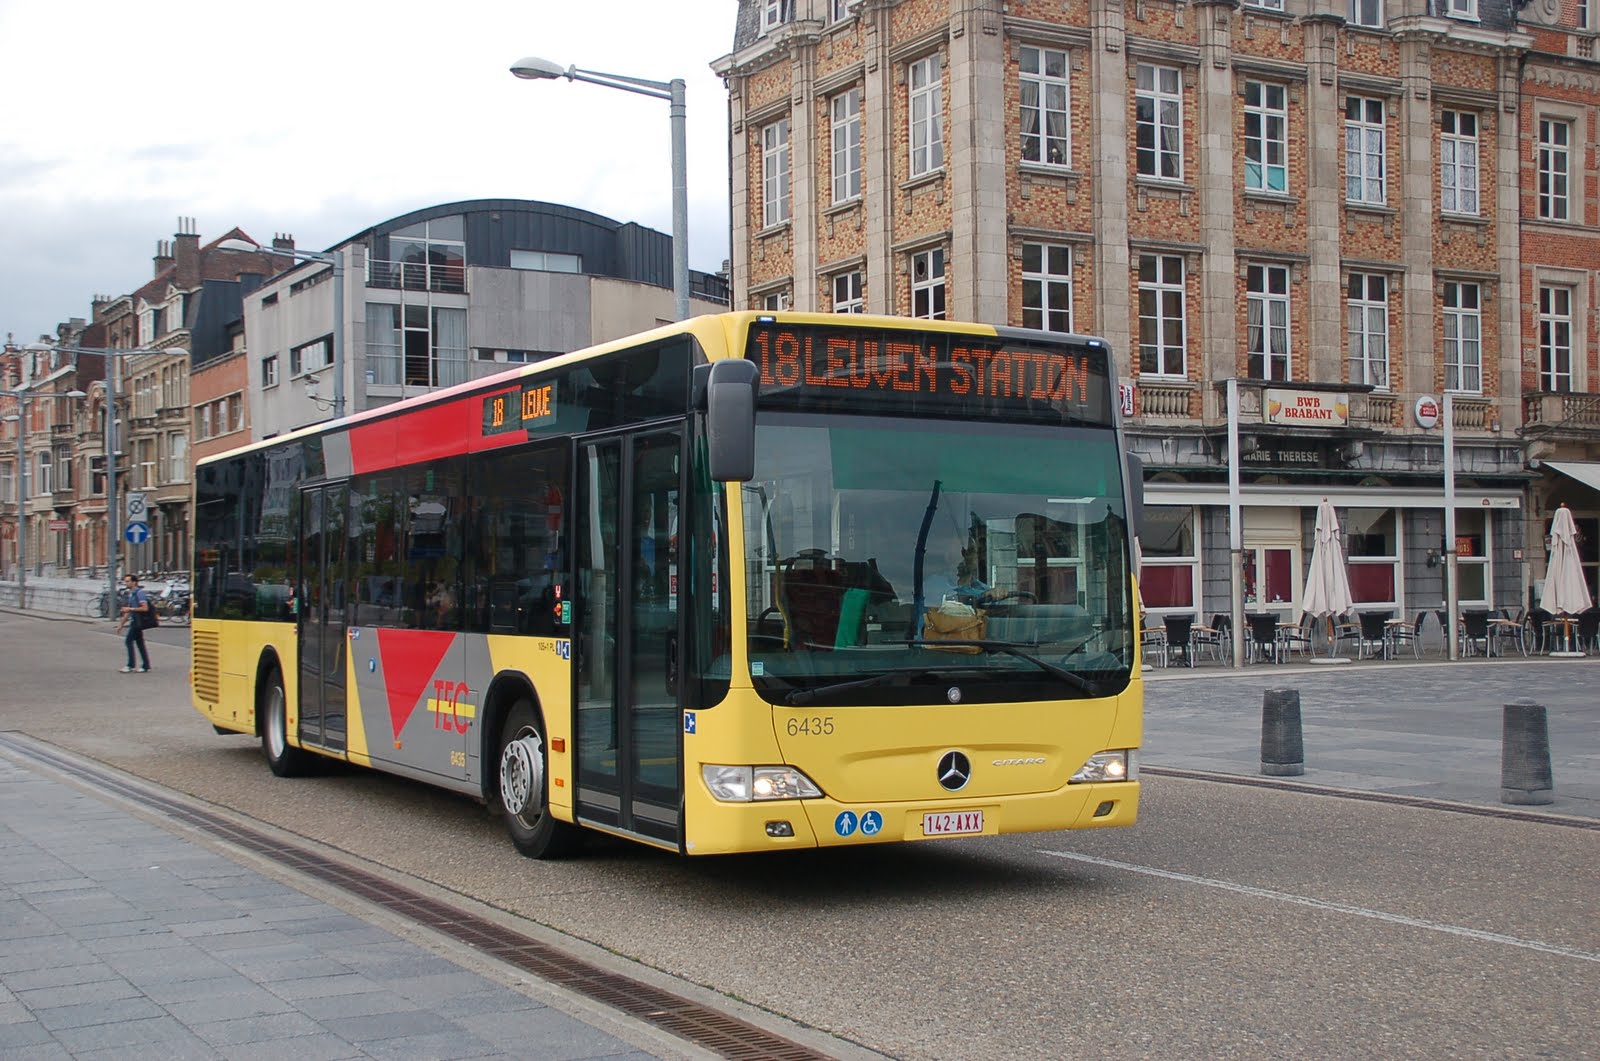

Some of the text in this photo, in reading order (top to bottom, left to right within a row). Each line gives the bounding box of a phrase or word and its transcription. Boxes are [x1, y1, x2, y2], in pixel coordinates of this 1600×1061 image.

[755, 331, 1088, 401] 18 LEUVEN STATION
[1297, 396, 1321, 408] BWB
[493, 398, 504, 427] 18
[1284, 407, 1333, 419] BRABANT
[1278, 451, 1319, 462] THERESE
[433, 680, 469, 735] TEC
[787, 717, 834, 736] 6435
[992, 758, 1046, 767] CITARO
